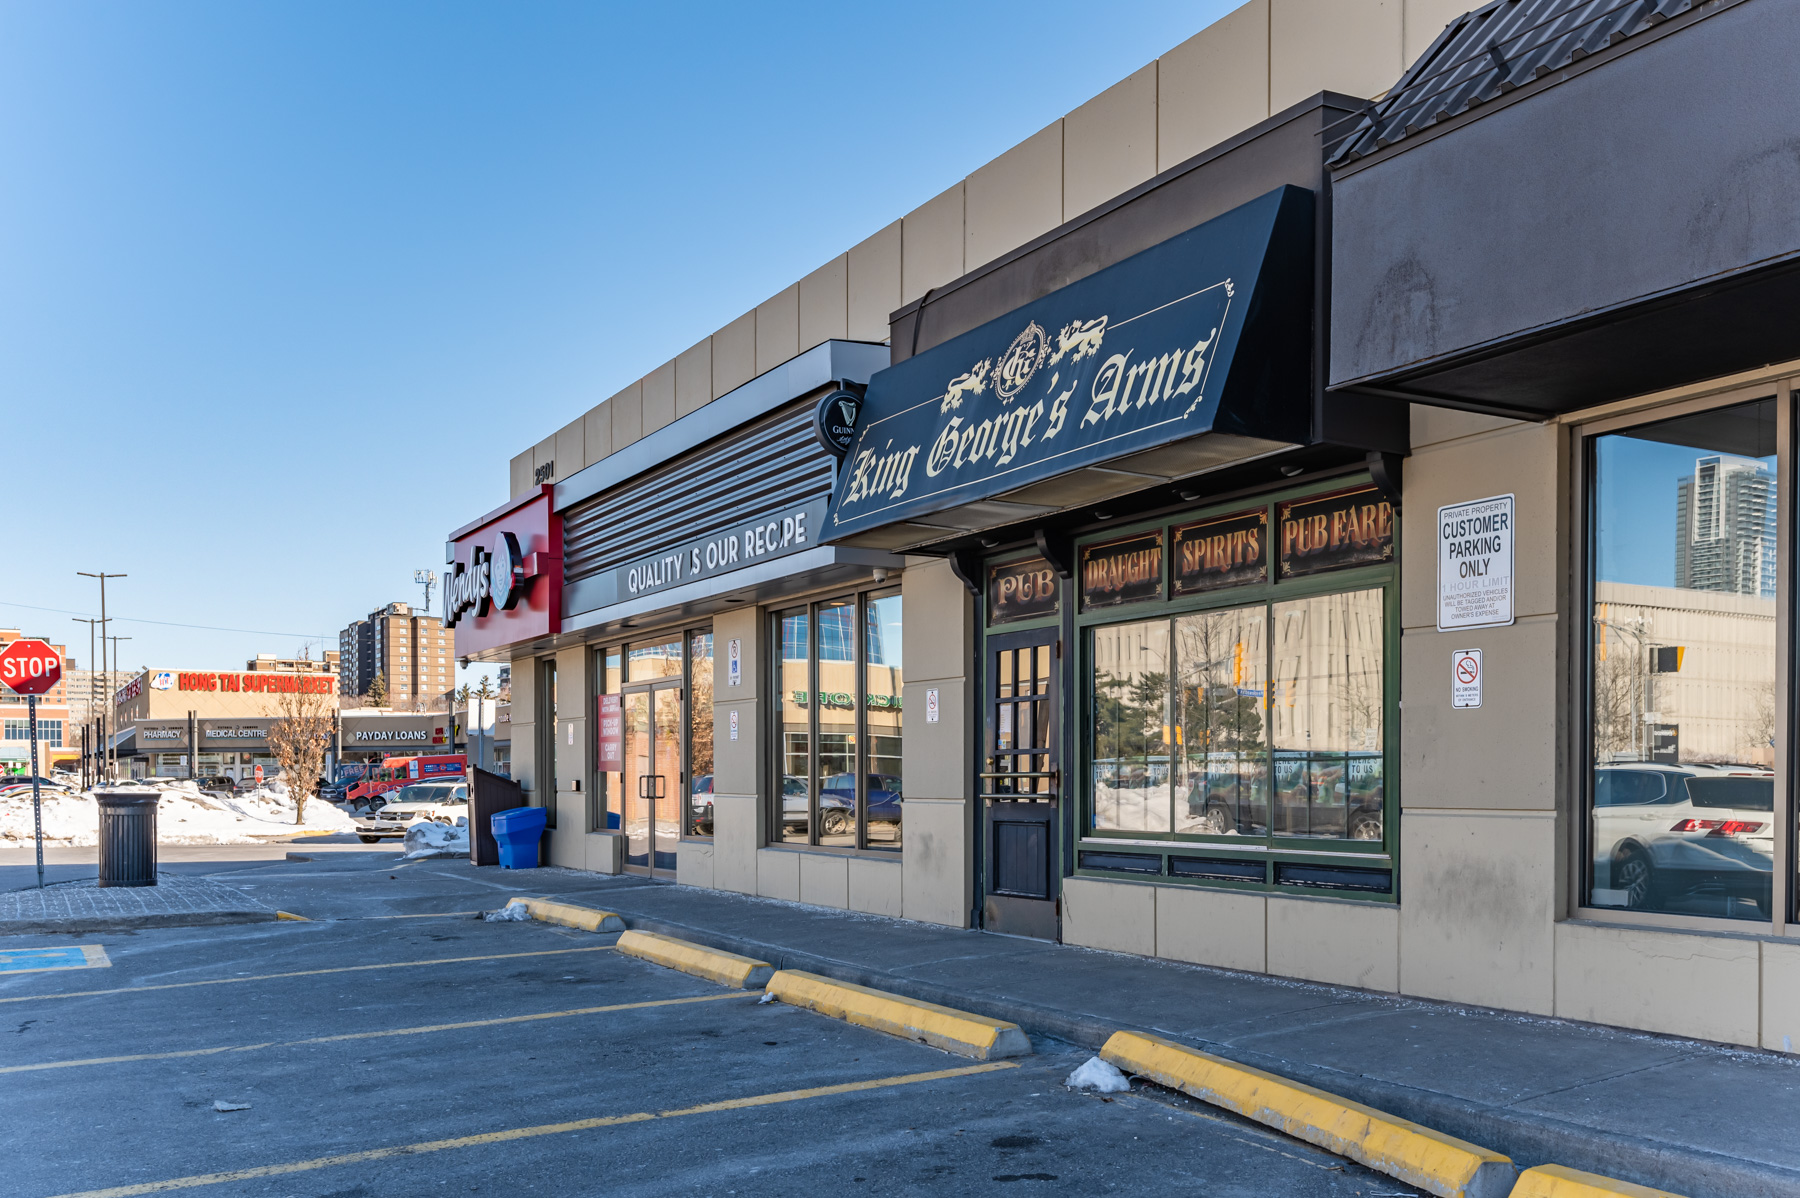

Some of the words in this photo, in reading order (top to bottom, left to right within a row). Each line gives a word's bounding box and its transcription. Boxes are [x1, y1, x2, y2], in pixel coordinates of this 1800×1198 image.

[843, 438, 920, 507] King
[926, 371, 1078, 478] George's
[1079, 327, 1217, 430] Arms
[535, 460, 554, 486] 2501
[1443, 508, 1470, 520] PRIVATE
[1471, 501, 1507, 515] PROPERTY
[1283, 513, 1328, 555] PUB
[1332, 500, 1393, 546] FARE
[1443, 512, 1509, 540] CUSTOMER
[1183, 527, 1260, 573] SPIRITS
[1449, 535, 1501, 560] PARKING
[628, 552, 684, 595] QUALITY
[706, 535, 739, 570] OUR
[1087, 547, 1161, 590] DRAUGHT
[1459, 558, 1491, 579] ONLY
[443, 545, 489, 628] Wendy's
[998, 569, 1054, 605] PUB
[1442, 584, 1446, 593] 1
[1450, 580, 1479, 592] HOUR
[1482, 575, 1509, 588] LIMIT
[1442, 590, 1482, 601] UNAUTHORIZED
[1482, 587, 1508, 597] VEHICLES
[1444, 600, 1456, 608] WILL
[1465, 597, 1486, 605] TAGGED
[1455, 605, 1474, 613] TOWED
[1474, 603, 1489, 611] AWAY
[1451, 611, 1474, 620] OWNER'S
[1475, 608, 1500, 618] EXPENSE
[3, 657, 58, 678] STOP
[178, 672, 217, 692] HONG
[219, 673, 240, 693] TAI
[243, 673, 335, 695] SUPERMARKET
[1462, 685, 1479, 693] SMOKING
[143, 730, 181, 739] PHARMACY
[205, 729, 237, 738] MEDICAL
[238, 729, 268, 738] CENTRE
[356, 731, 394, 741] PAYDAY
[395, 730, 427, 740] LOANS
[344, 764, 365, 777] FREE
[1283, 765, 1293, 774] US
[1351, 765, 1361, 774] TO
[1363, 765, 1374, 774] US
